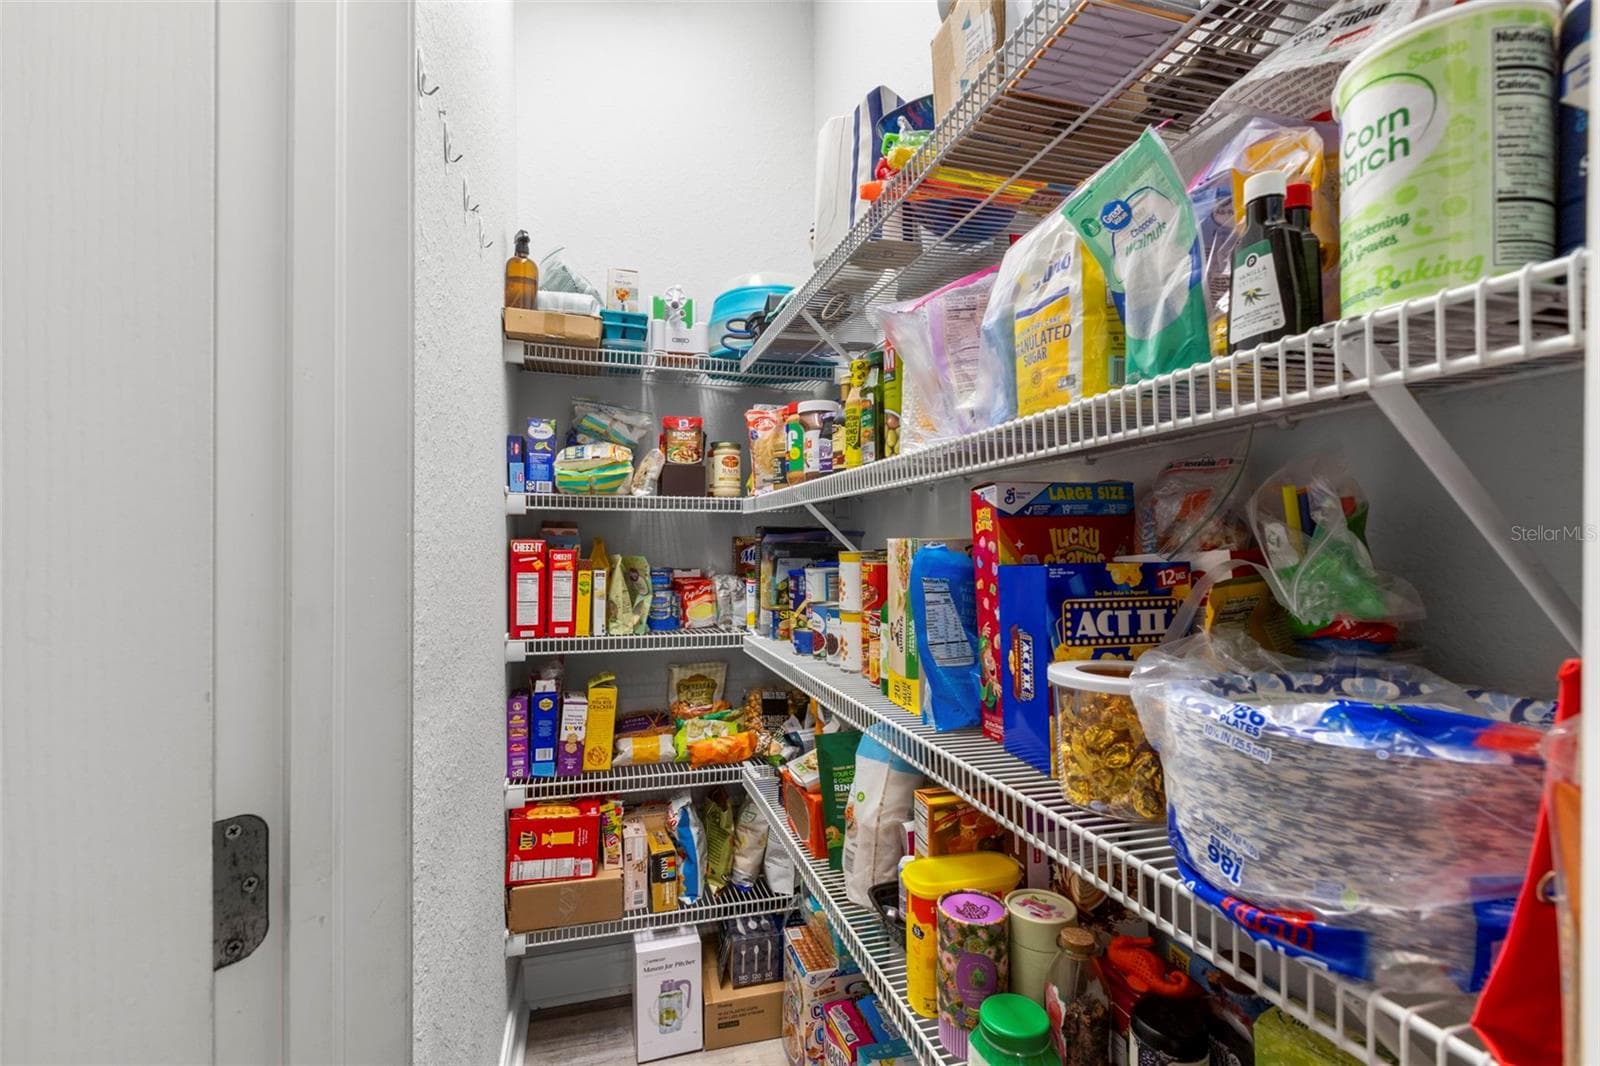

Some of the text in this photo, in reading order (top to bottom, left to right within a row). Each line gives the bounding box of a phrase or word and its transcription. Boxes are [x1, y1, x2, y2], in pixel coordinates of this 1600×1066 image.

[1024, 346, 1048, 368] SUGAR
[1047, 486, 1094, 500] LARGE
[1097, 486, 1126, 500] SIZE
[1158, 568, 1177, 586] 12
[1075, 608, 1168, 638] ACT II
[1219, 714, 1260, 737] PLATES
[834, 783, 850, 792] RIN
[519, 831, 533, 850] RITZ
[660, 857, 669, 879] KIND
[1207, 844, 1241, 883] 186
